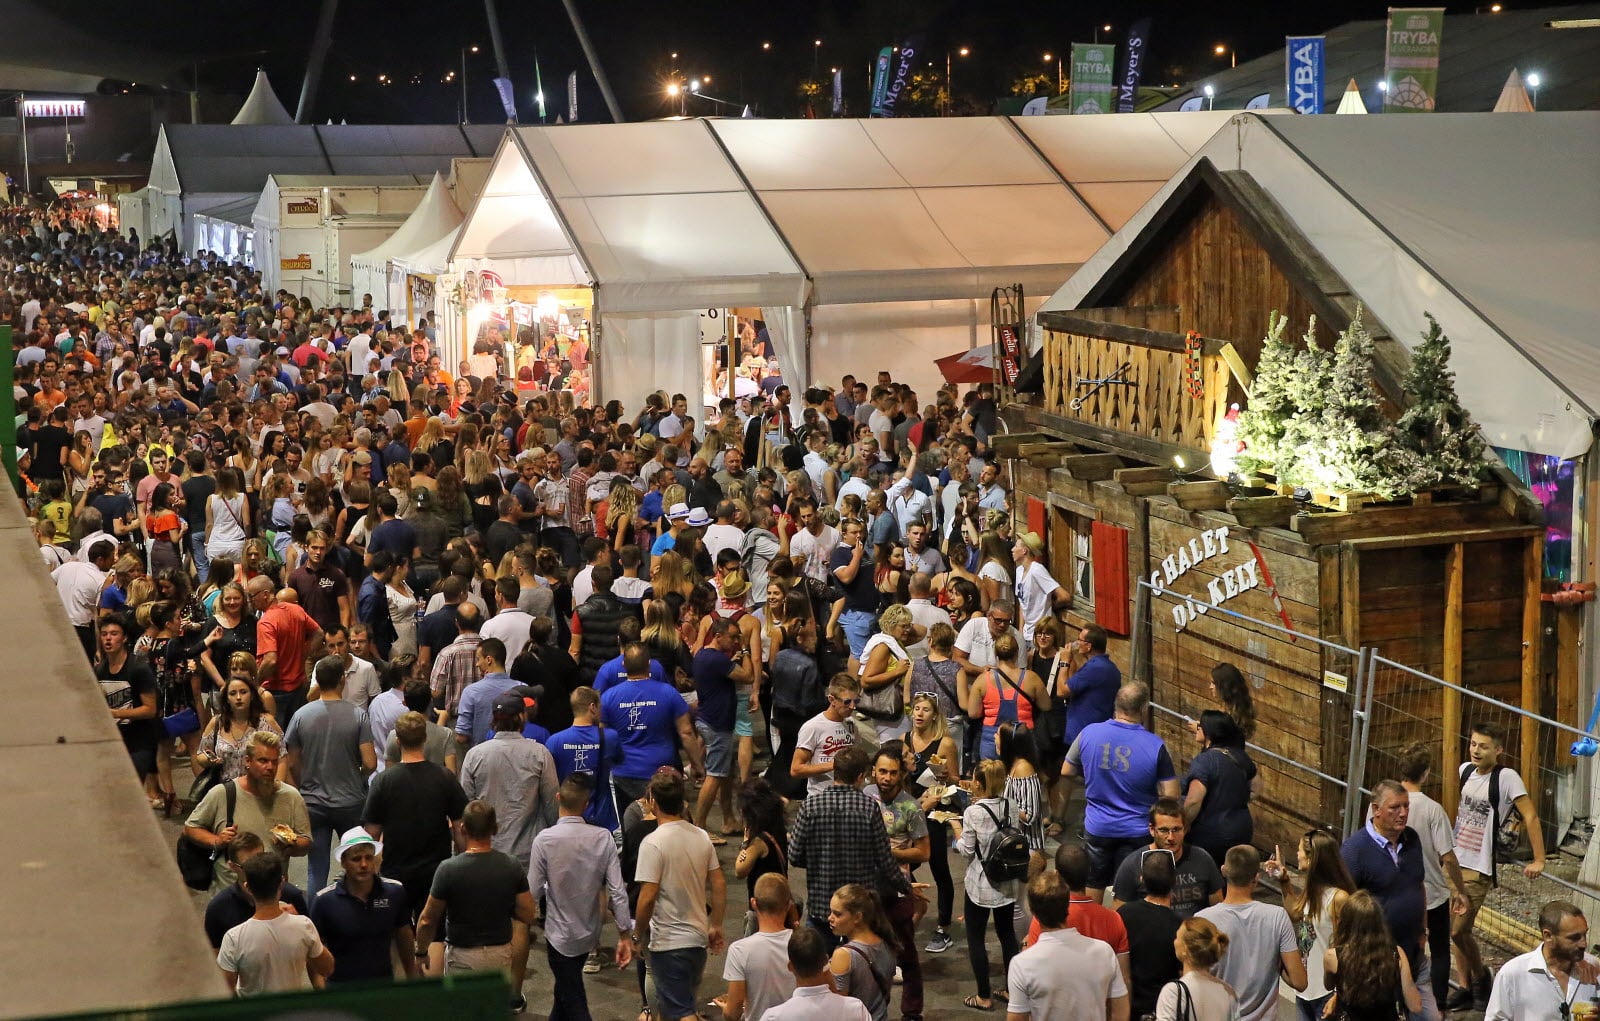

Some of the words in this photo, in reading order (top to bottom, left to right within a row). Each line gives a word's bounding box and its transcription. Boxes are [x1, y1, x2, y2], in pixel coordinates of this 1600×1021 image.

[1392, 31, 1438, 44] TRYBA
[1076, 62, 1112, 74] TRYBA
[1151, 526, 1230, 596] CHALET
[823, 735, 855, 750] SuperDr
[1098, 742, 1131, 772] 18
